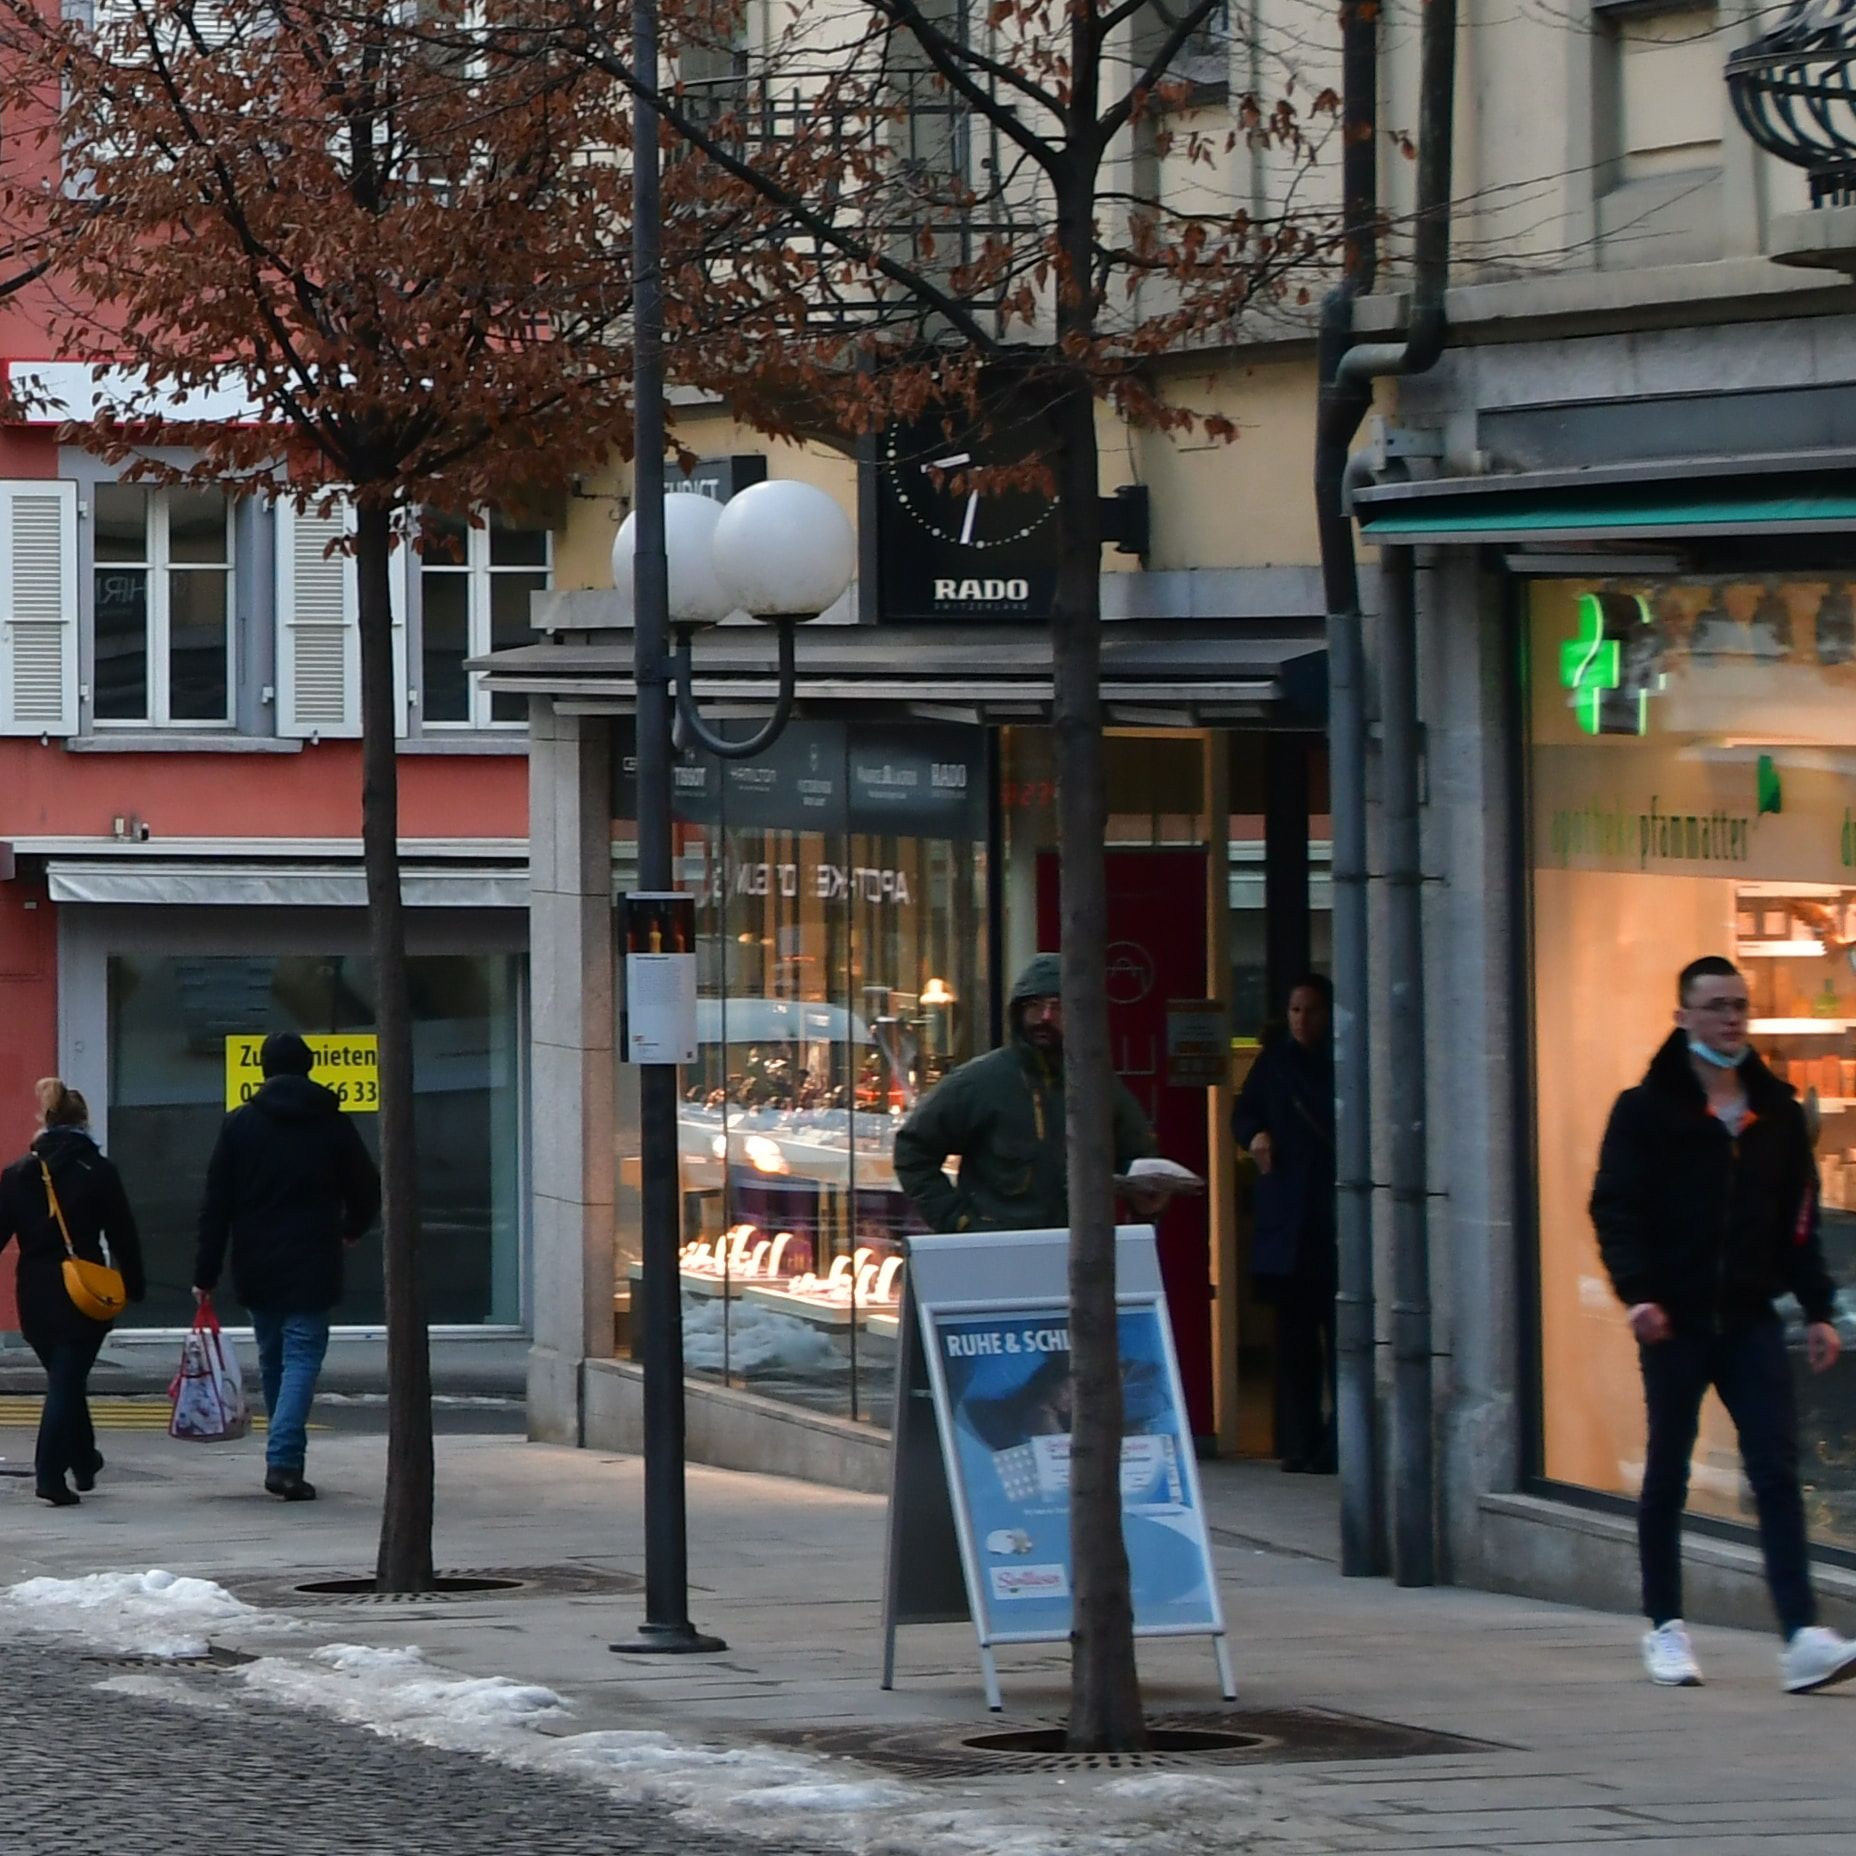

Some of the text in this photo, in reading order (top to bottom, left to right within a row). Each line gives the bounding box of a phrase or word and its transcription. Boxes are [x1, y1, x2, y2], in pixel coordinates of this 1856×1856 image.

[933, 578, 1029, 600] RADO
[354, 1081, 377, 1102] 33
[946, 1333, 1003, 1357] RUHE
[1005, 1332, 1022, 1353] &
